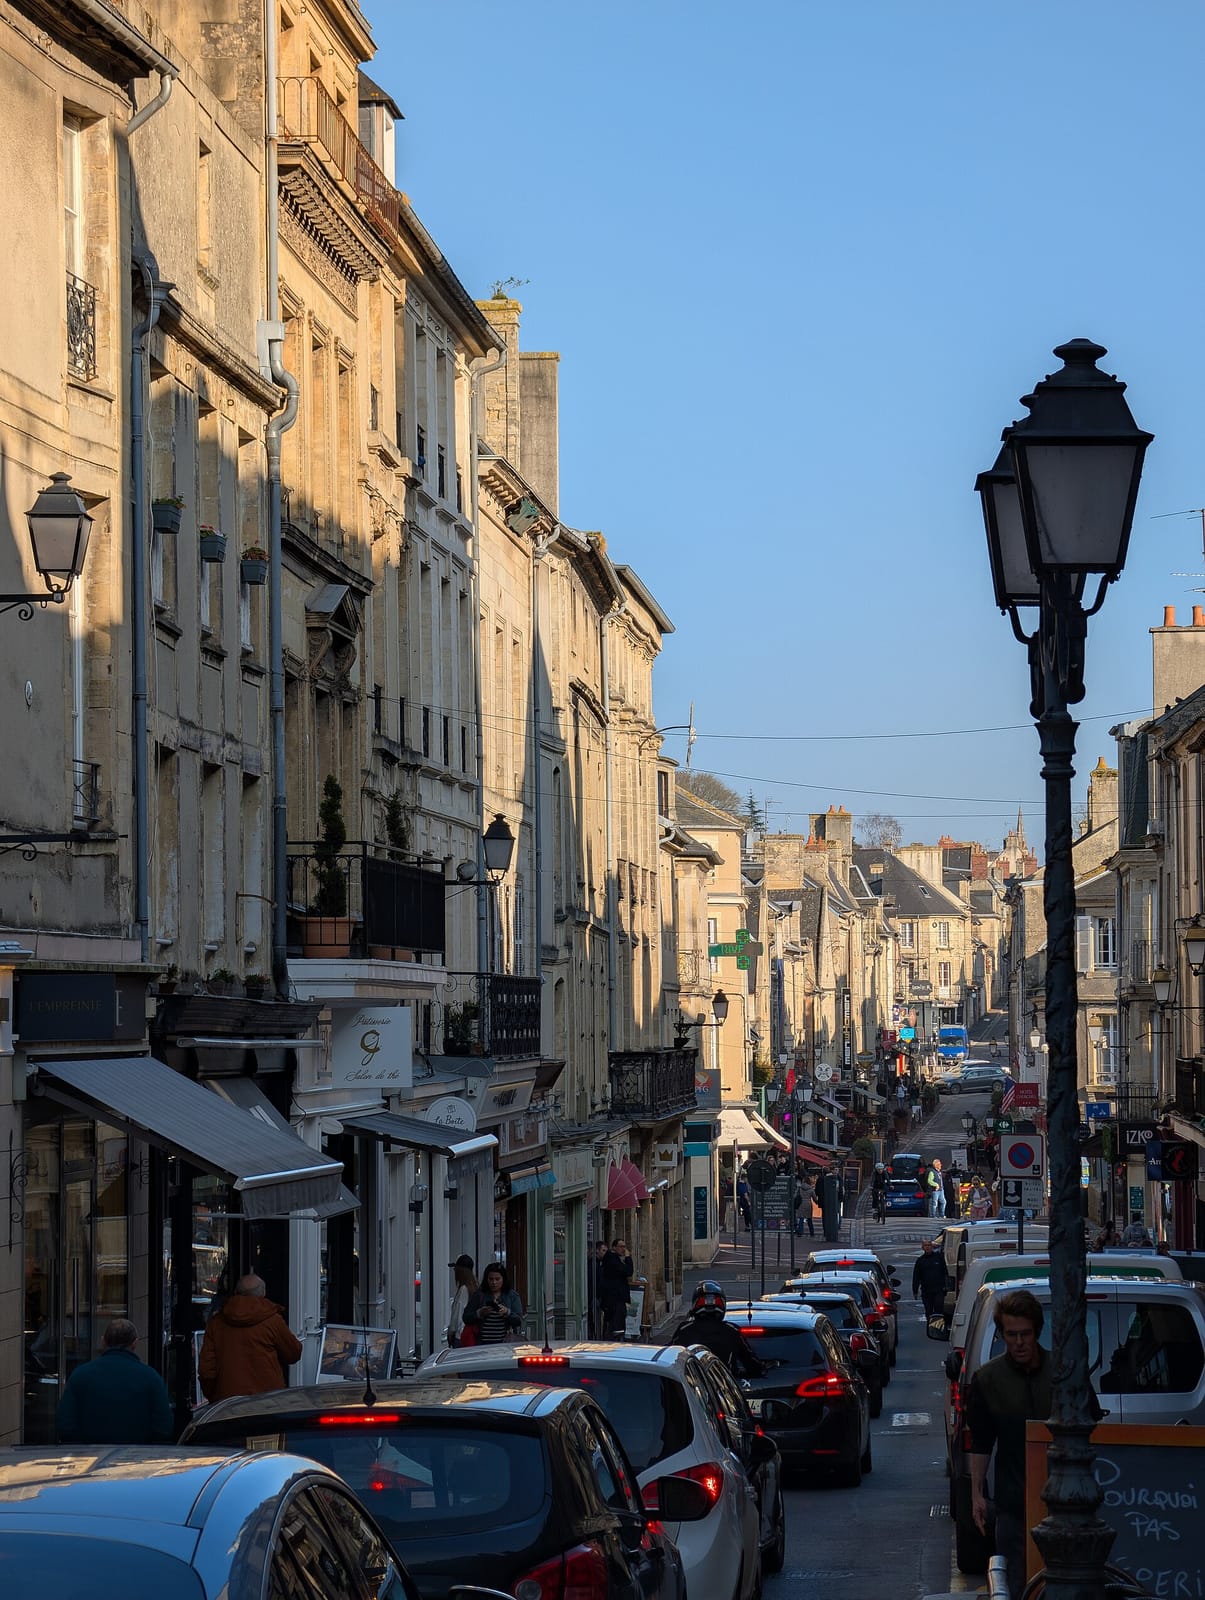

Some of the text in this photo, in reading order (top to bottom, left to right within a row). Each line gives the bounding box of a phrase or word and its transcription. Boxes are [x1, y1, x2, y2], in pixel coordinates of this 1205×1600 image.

[344, 1069, 372, 1081] Salon
[375, 1069, 385, 1079] de
[1124, 1511, 1180, 1541] PAS
